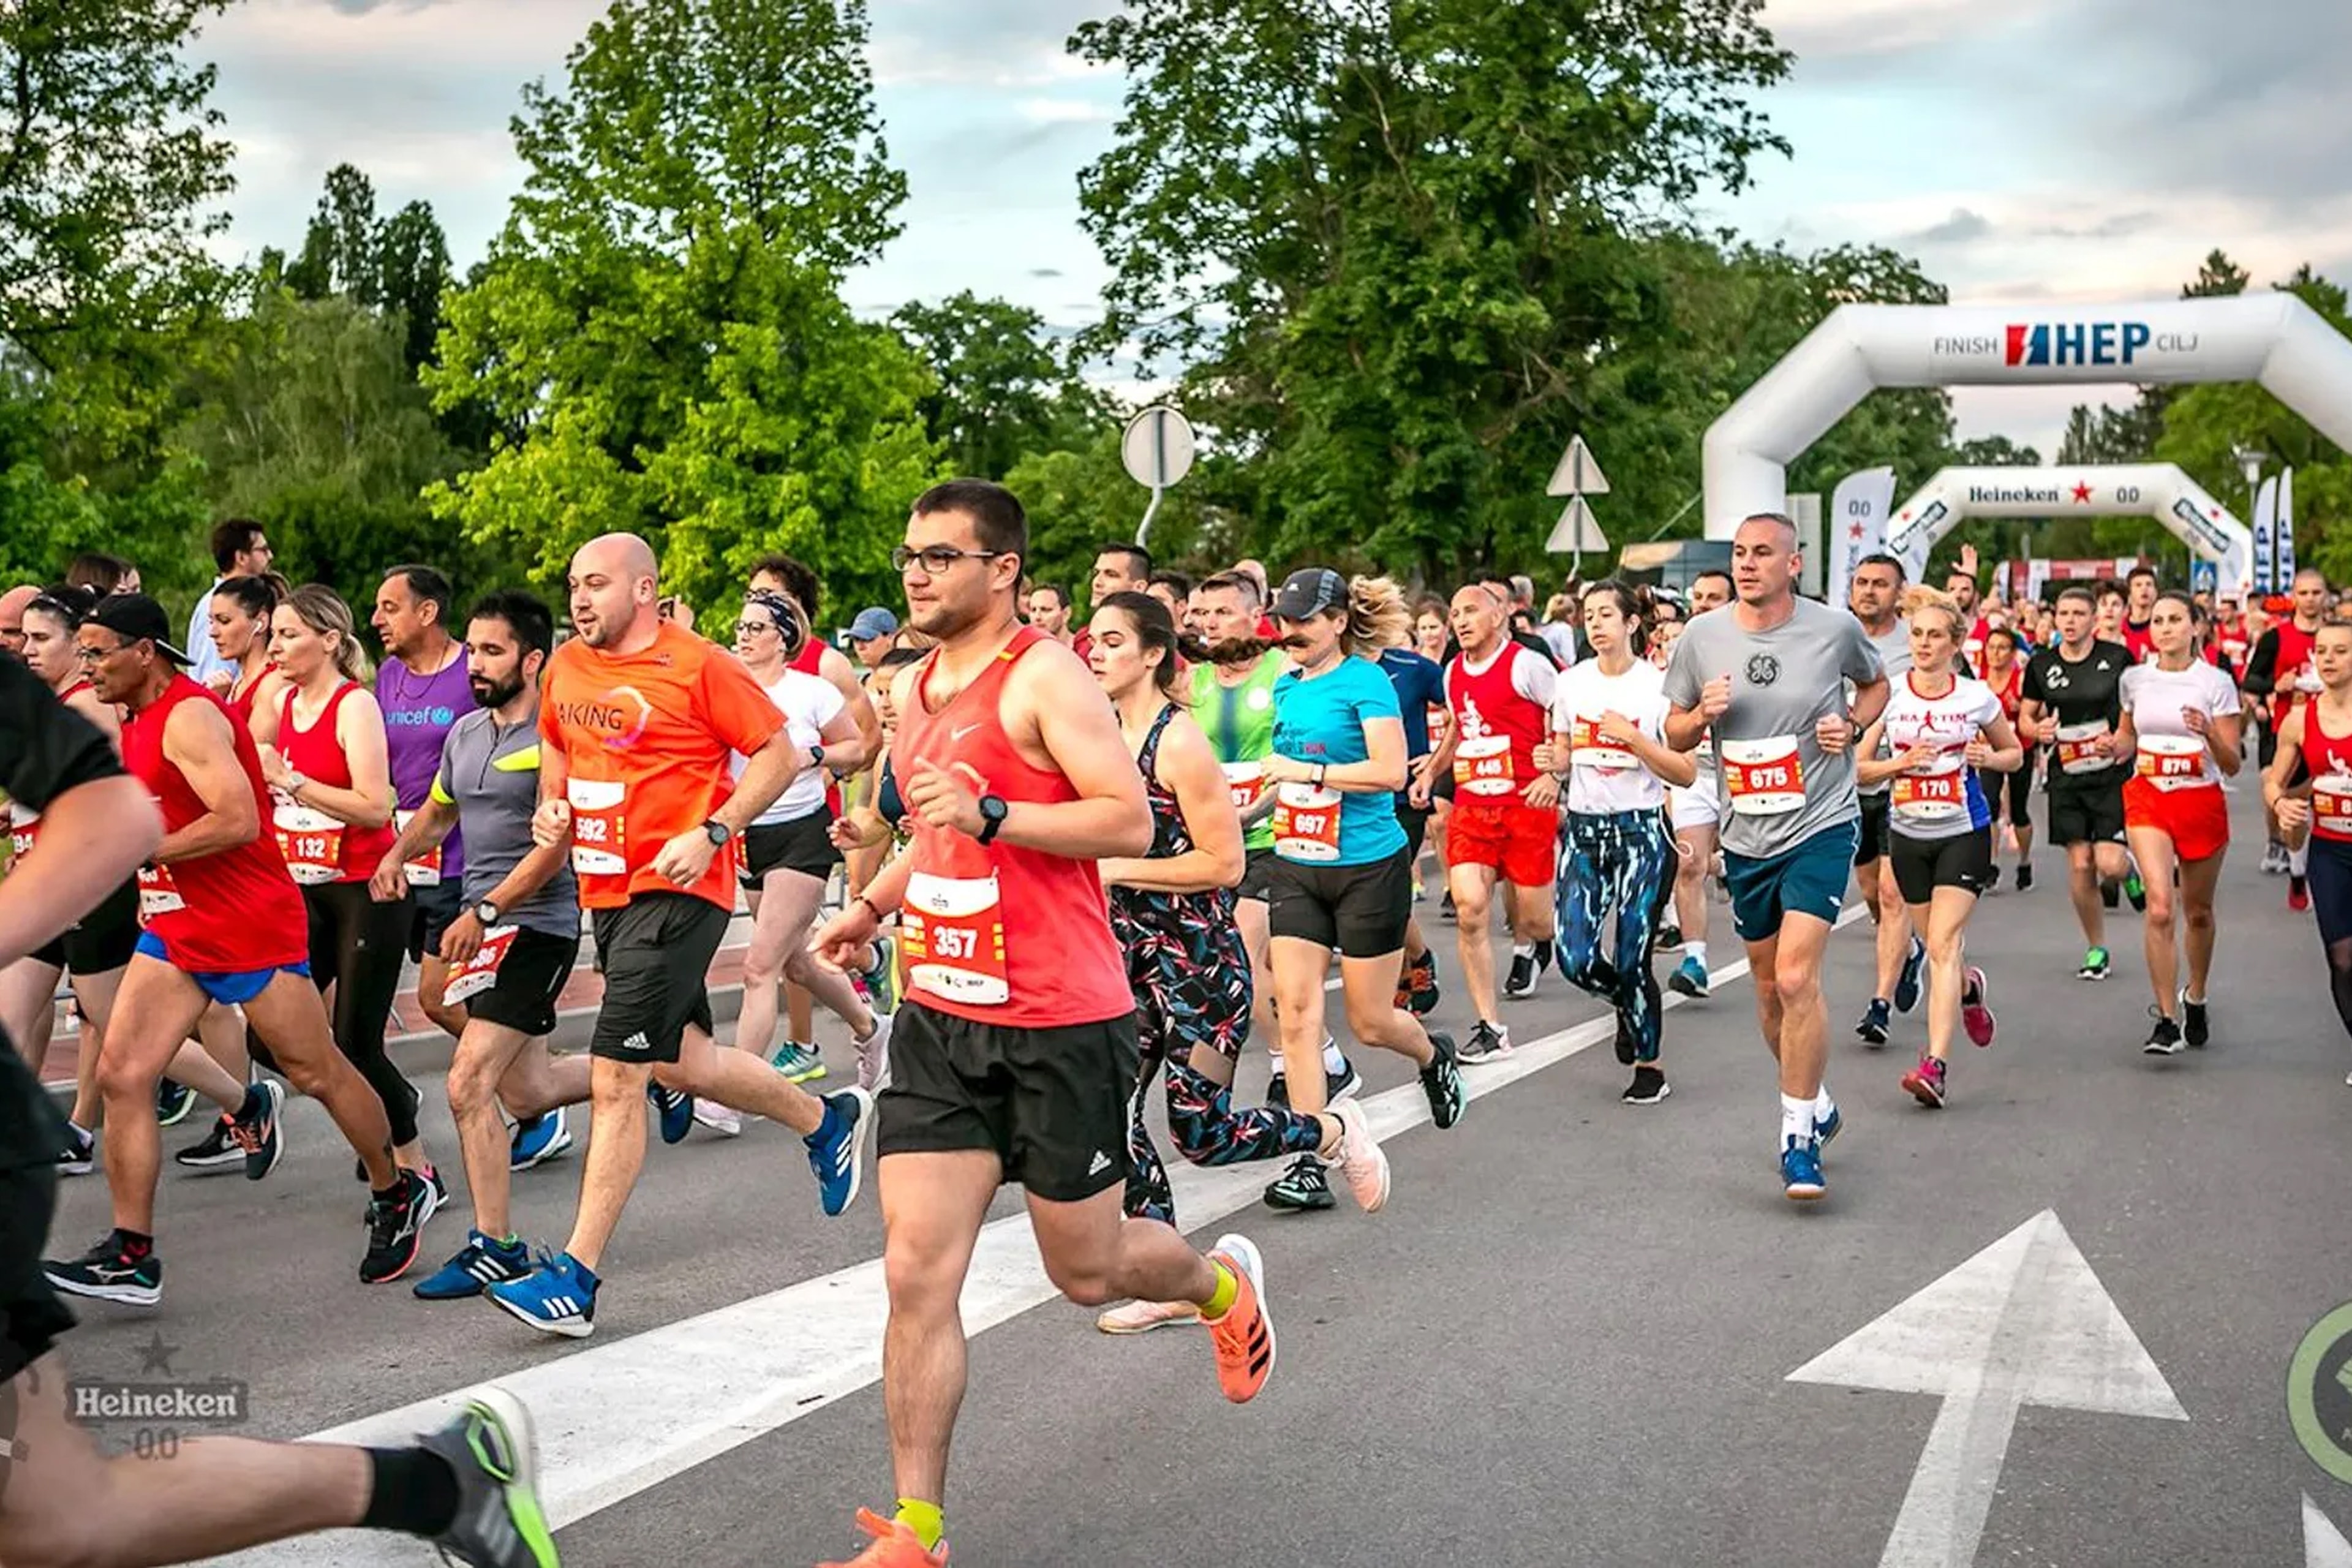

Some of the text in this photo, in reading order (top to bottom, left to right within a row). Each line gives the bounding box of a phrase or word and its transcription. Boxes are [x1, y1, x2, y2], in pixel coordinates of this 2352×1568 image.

[1934, 323, 2198, 366] FINISH HEP CILJ
[1969, 486, 2059, 502] Heineken
[386, 706, 431, 725] unicef
[1750, 766, 1789, 789] 675
[1918, 779, 1950, 797] 170
[295, 837, 326, 859] 132
[933, 925, 978, 959] 357
